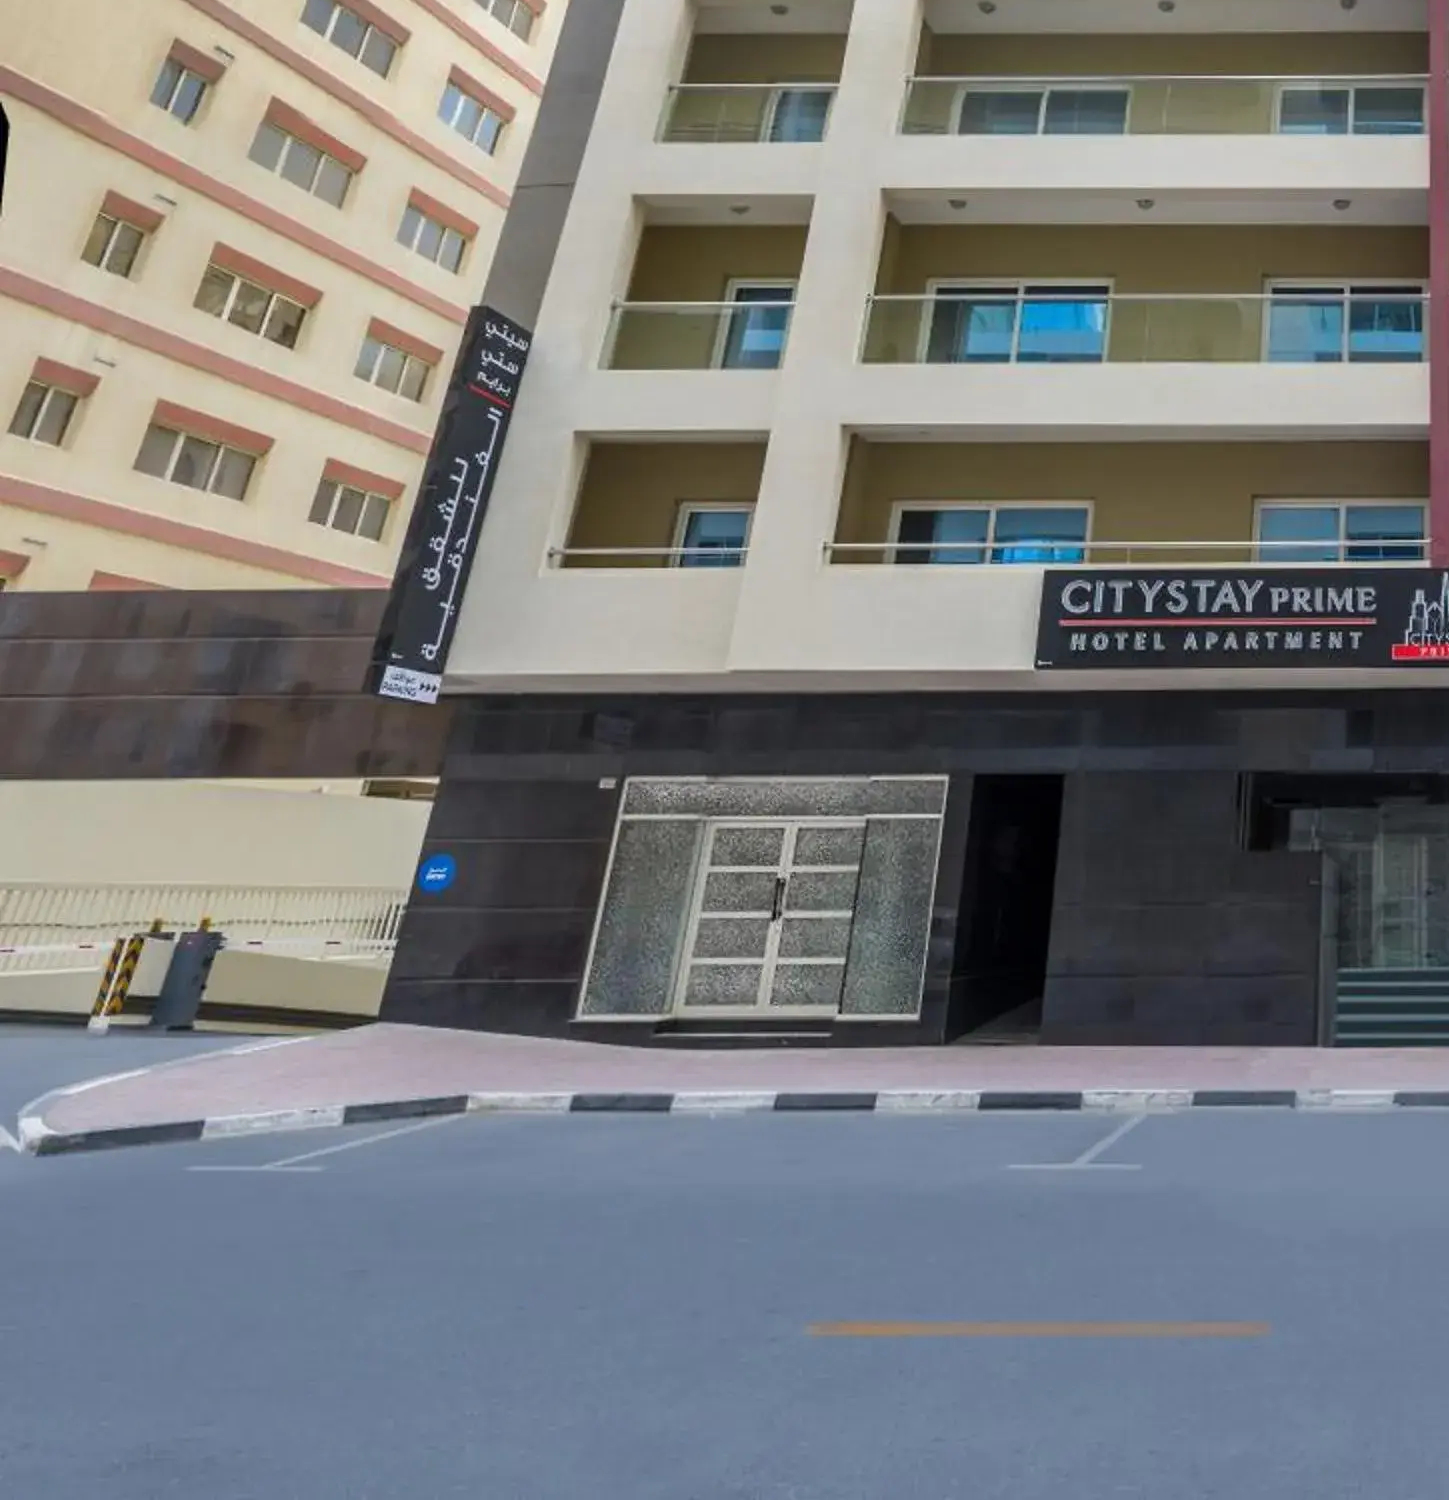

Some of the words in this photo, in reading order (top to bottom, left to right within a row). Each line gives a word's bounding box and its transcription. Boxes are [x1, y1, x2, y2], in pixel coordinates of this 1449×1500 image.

[485, 321, 529, 351] سيتي
[481, 349, 519, 375] ستي
[477, 371, 511, 397] برايم
[421, 406, 504, 660] الفندقية
[425, 456, 469, 590] للشقق
[1060, 579, 1264, 615] CITYSTAY
[1269, 586, 1378, 614] PRIME
[1069, 631, 1166, 651] HOTEL
[1183, 631, 1364, 651] APARTMENT
